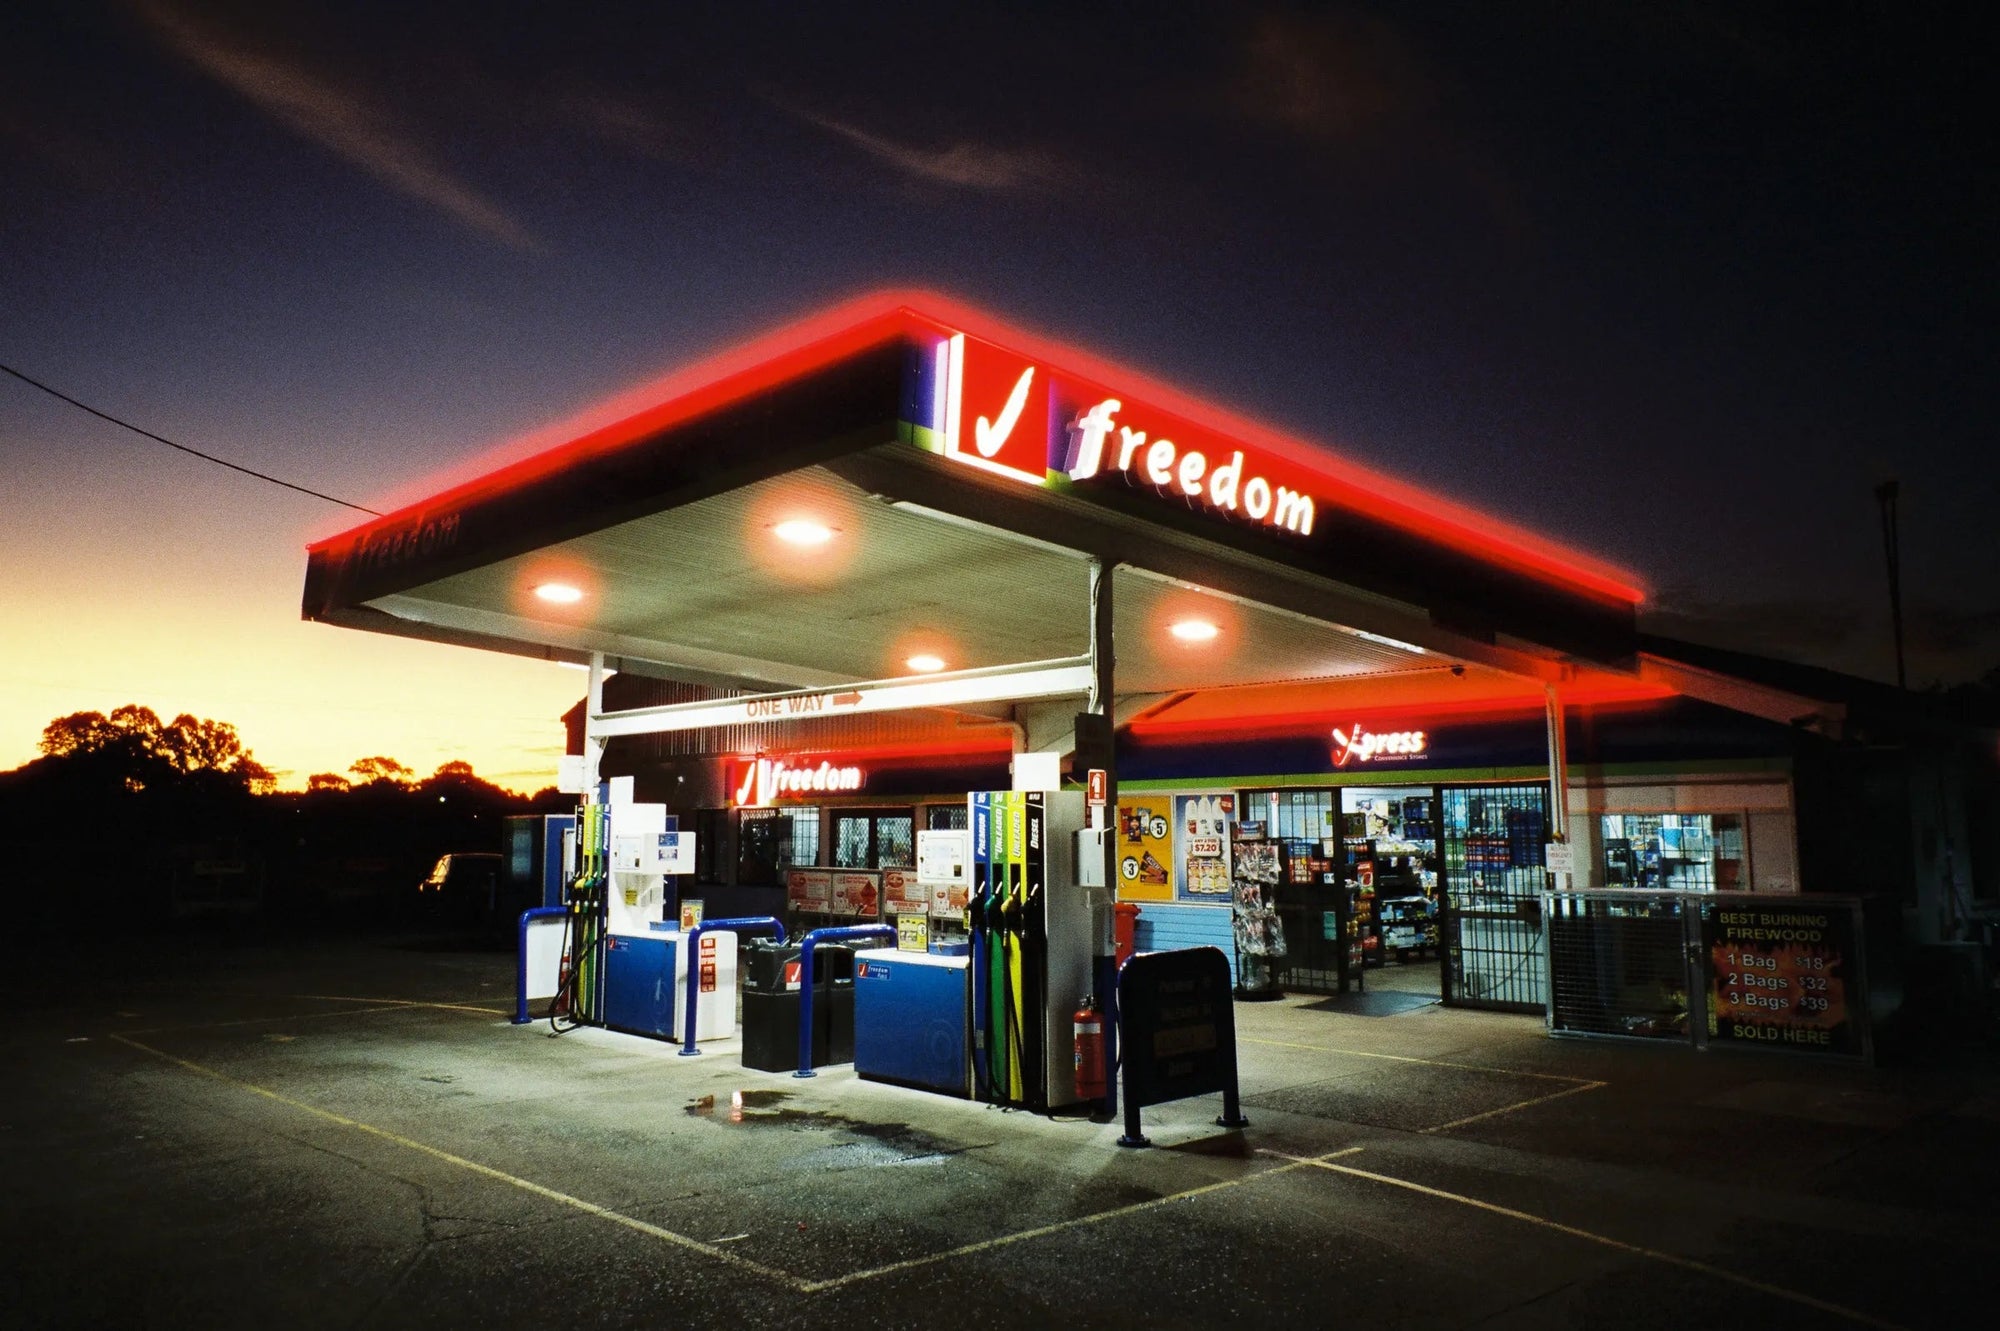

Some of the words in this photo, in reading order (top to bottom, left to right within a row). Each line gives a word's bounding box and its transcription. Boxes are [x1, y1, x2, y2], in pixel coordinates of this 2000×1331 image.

[1068, 398, 1315, 536] freedom
[747, 698, 782, 717] ONE
[787, 693, 826, 713] WAY
[769, 760, 861, 799] freedom
[1030, 818, 1039, 849] DIESEL
[1194, 844, 1217, 852] $7.20
[1720, 912, 1756, 924] BEST
[1761, 914, 1828, 927] BURNING
[1727, 927, 1822, 942] FIREWOOD
[1728, 954, 1735, 965] 1
[1742, 954, 1777, 971] Bag
[1796, 956, 1824, 970] $18
[1728, 973, 1738, 985] 2
[1743, 973, 1788, 990] Bags
[1800, 976, 1827, 991] $32
[1730, 993, 1740, 1005] 3
[1745, 993, 1789, 1010] Bags
[1801, 996, 1829, 1011] $39
[1733, 1024, 1778, 1040] SOLD
[1783, 1028, 1831, 1045] HERE
